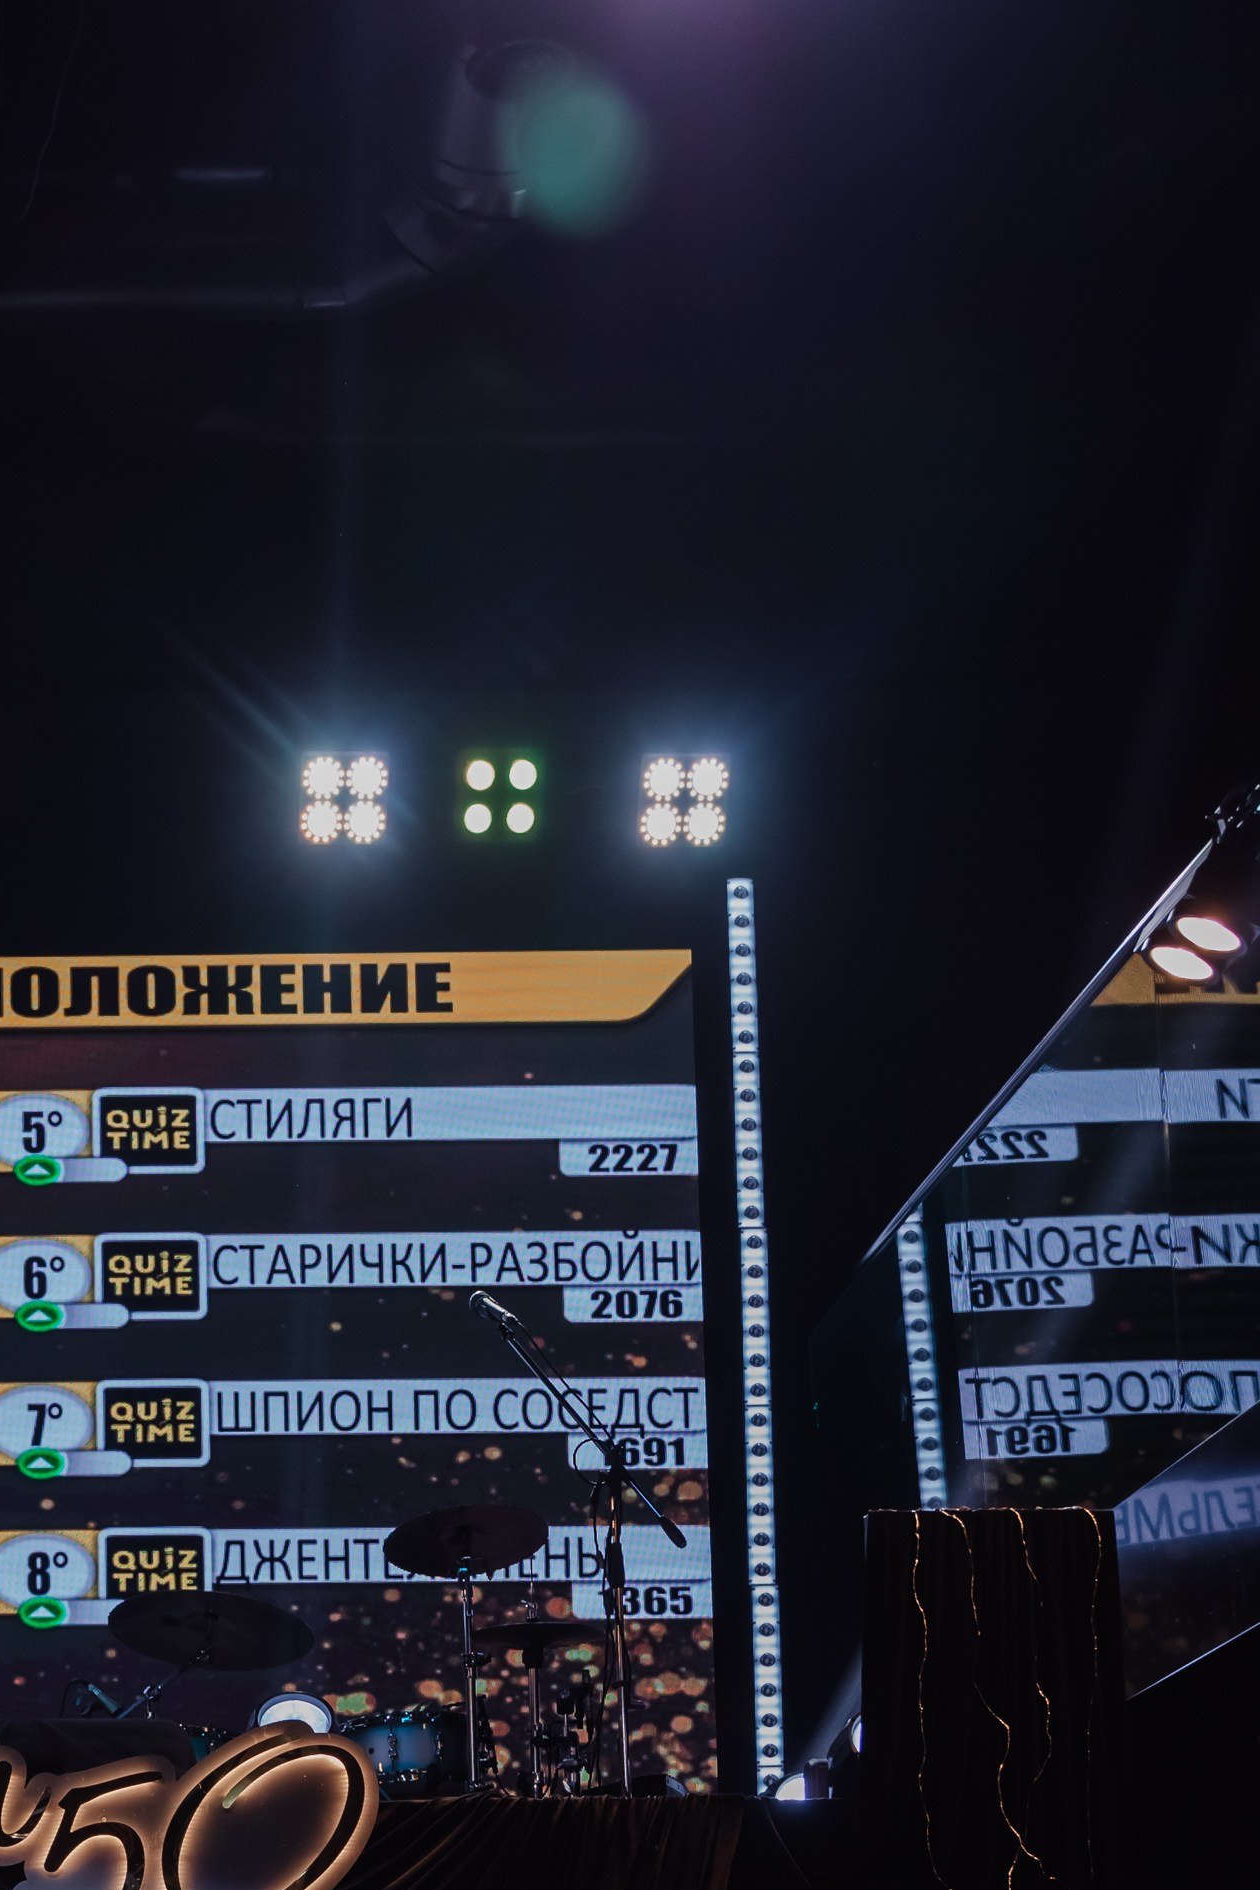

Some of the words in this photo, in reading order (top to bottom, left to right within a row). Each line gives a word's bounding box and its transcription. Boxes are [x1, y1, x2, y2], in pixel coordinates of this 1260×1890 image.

[210, 1097, 413, 1140] СТИЛЯГИ
[106, 1130, 190, 1151] TIME
[587, 1143, 678, 1173] 2227
[108, 1277, 192, 1296] TIME
[590, 1290, 683, 1318] 2076
[217, 1389, 394, 1432] ШПИОН
[413, 1388, 477, 1431] ПО
[110, 1424, 195, 1443] TIME
[603, 1437, 685, 1467] 691
[112, 1573, 197, 1592] TIME
[605, 1587, 693, 1616] 365
